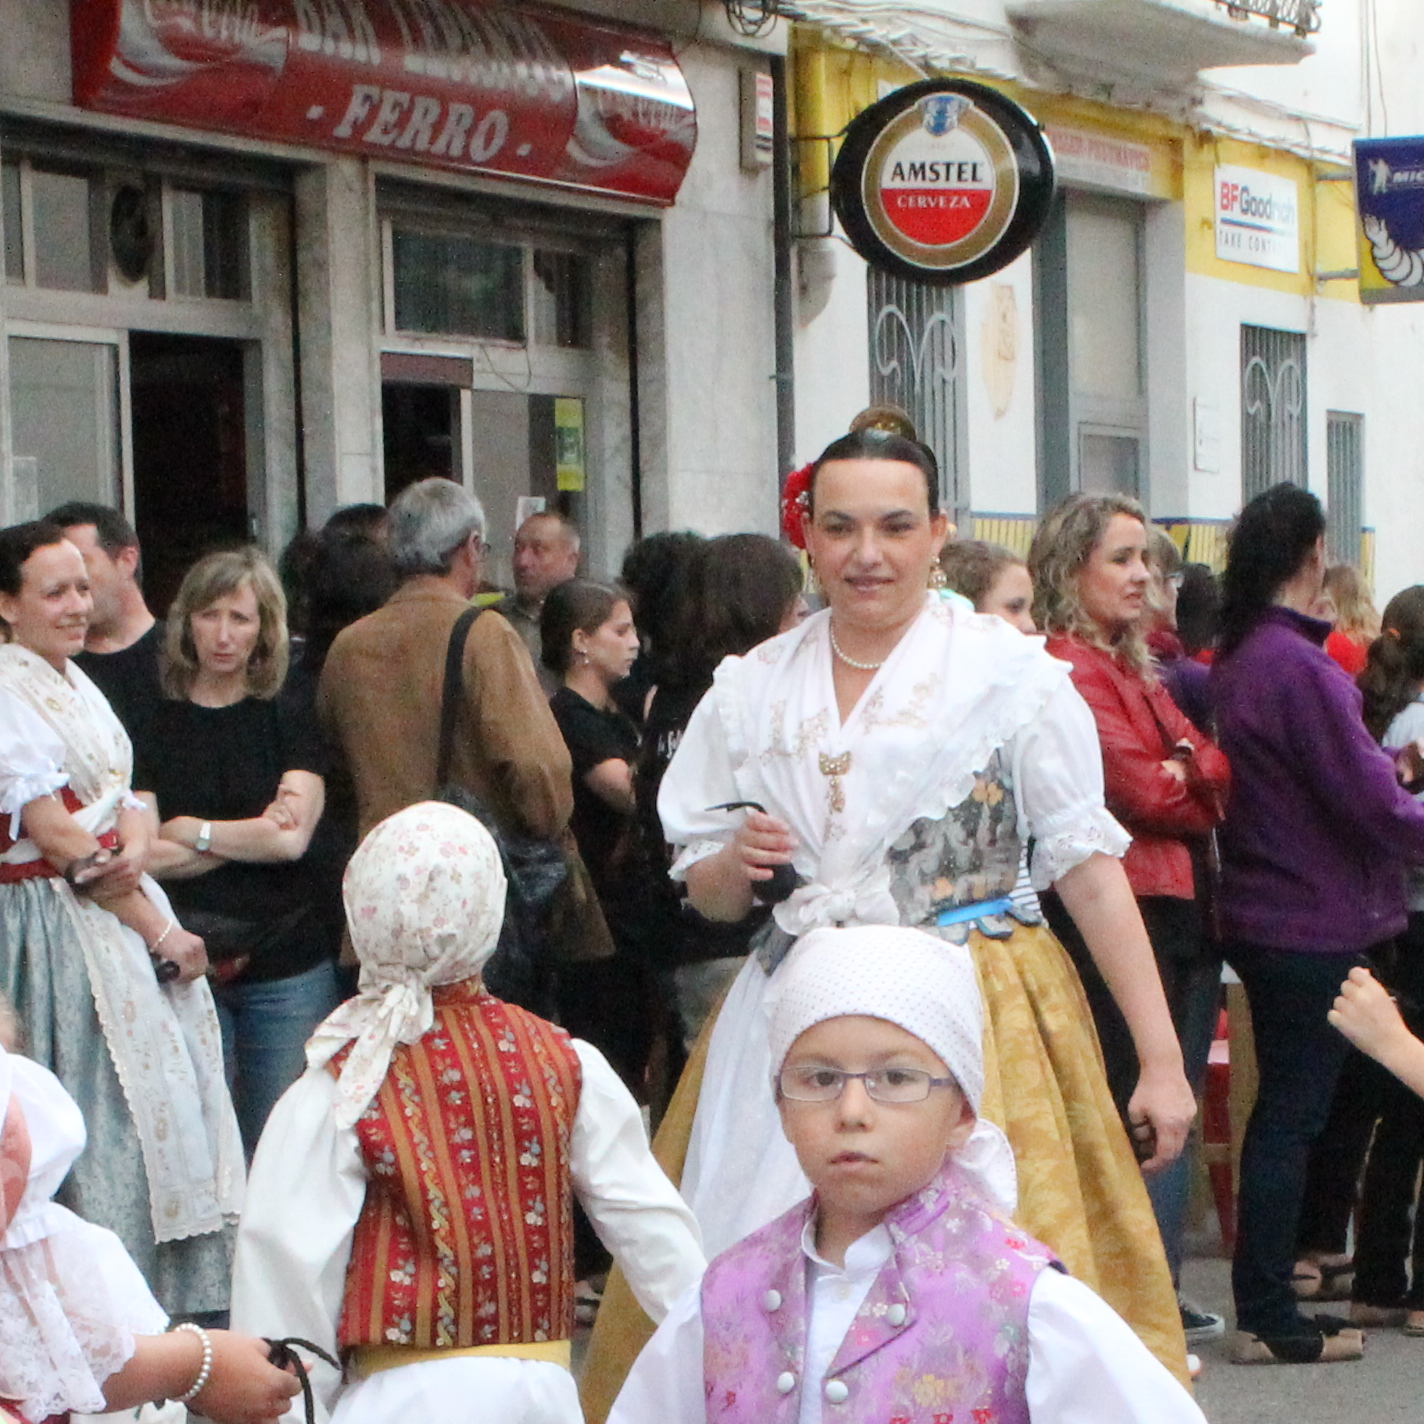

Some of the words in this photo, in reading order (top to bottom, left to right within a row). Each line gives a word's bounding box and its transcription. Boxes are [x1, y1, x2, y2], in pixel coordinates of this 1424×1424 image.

[332, 83, 509, 163] FERRO
[891, 161, 983, 183] AMSTEL
[896, 194, 972, 210] CERVEZA
[1219, 229, 1242, 249] TAKE
